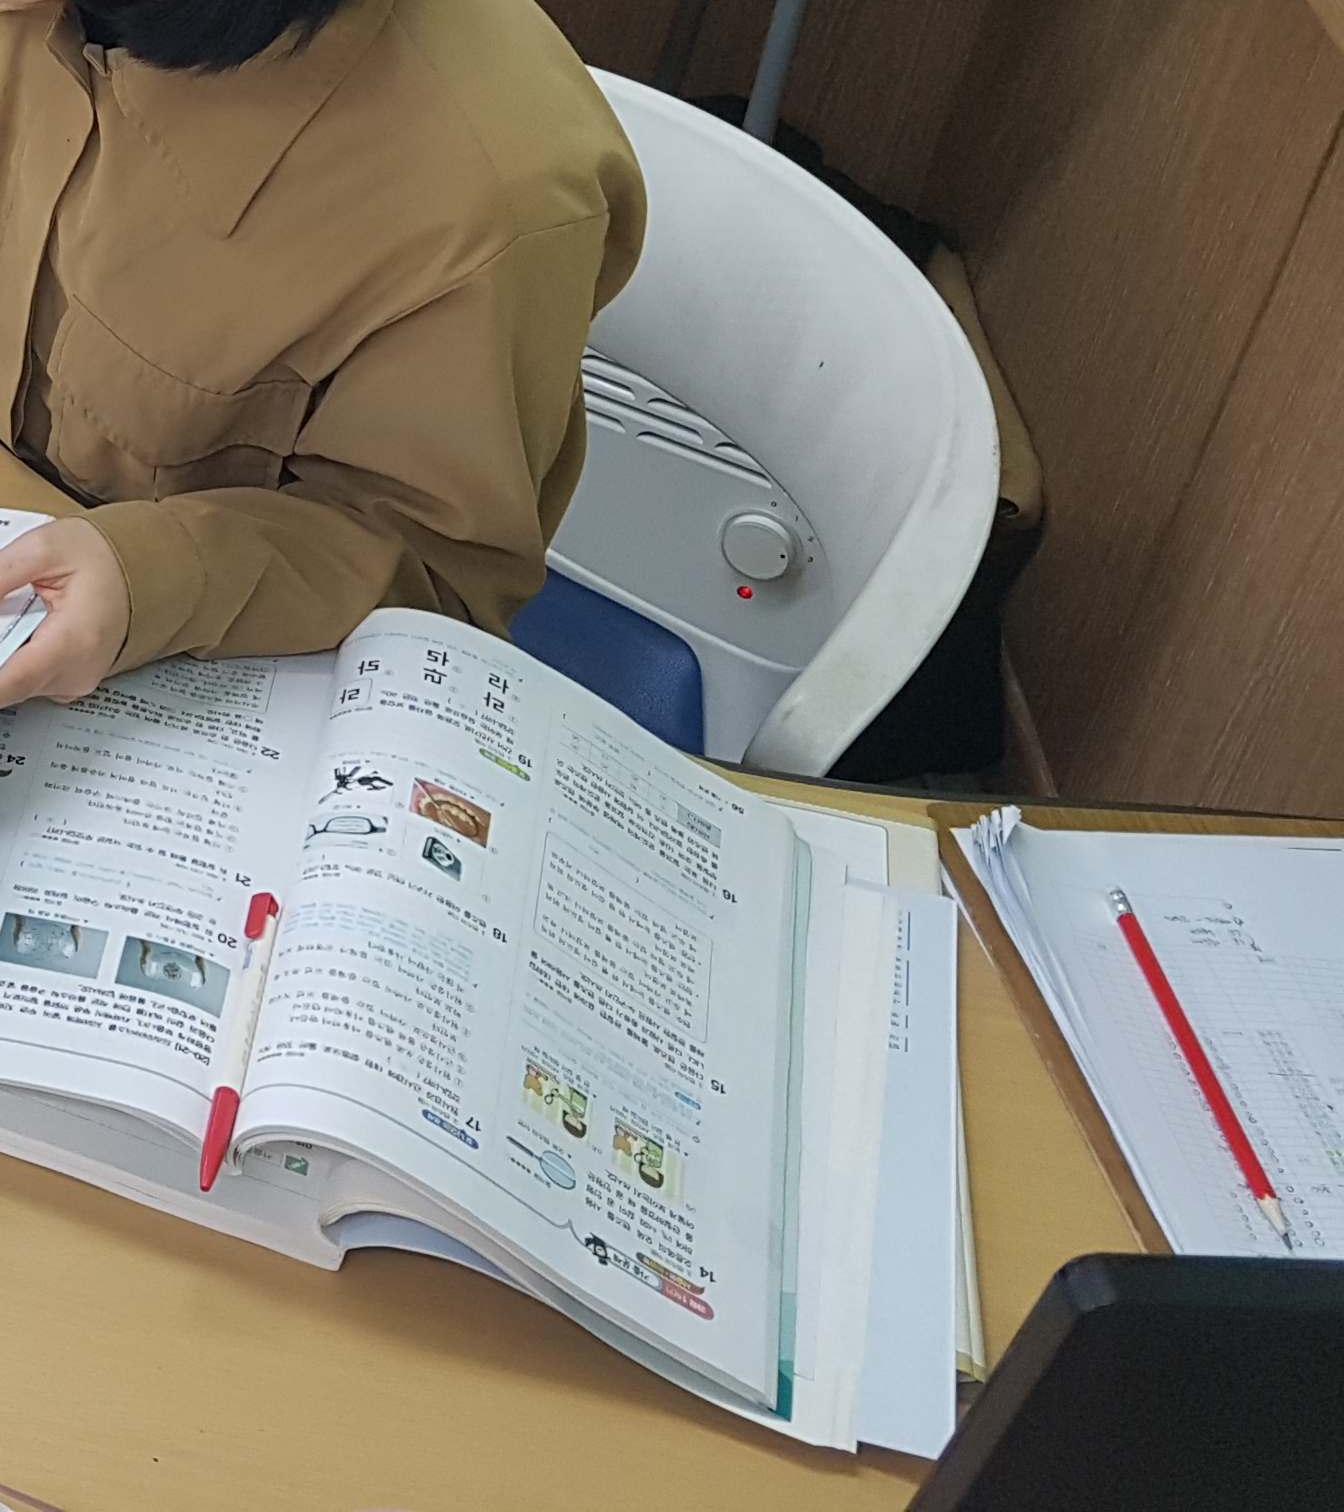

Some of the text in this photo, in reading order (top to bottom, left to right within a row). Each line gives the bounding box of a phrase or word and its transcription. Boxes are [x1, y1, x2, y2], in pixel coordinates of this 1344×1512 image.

[7, 754, 26, 766] 24
[260, 746, 280, 760] 22
[518, 754, 532, 769] 19
[235, 872, 251, 887] 21
[722, 889, 738, 905] 16
[215, 931, 239, 949] 20
[492, 927, 508, 944] 18
[710, 1079, 726, 1095] 15
[465, 1116, 482, 1133] 17
[699, 1266, 716, 1283] 14
